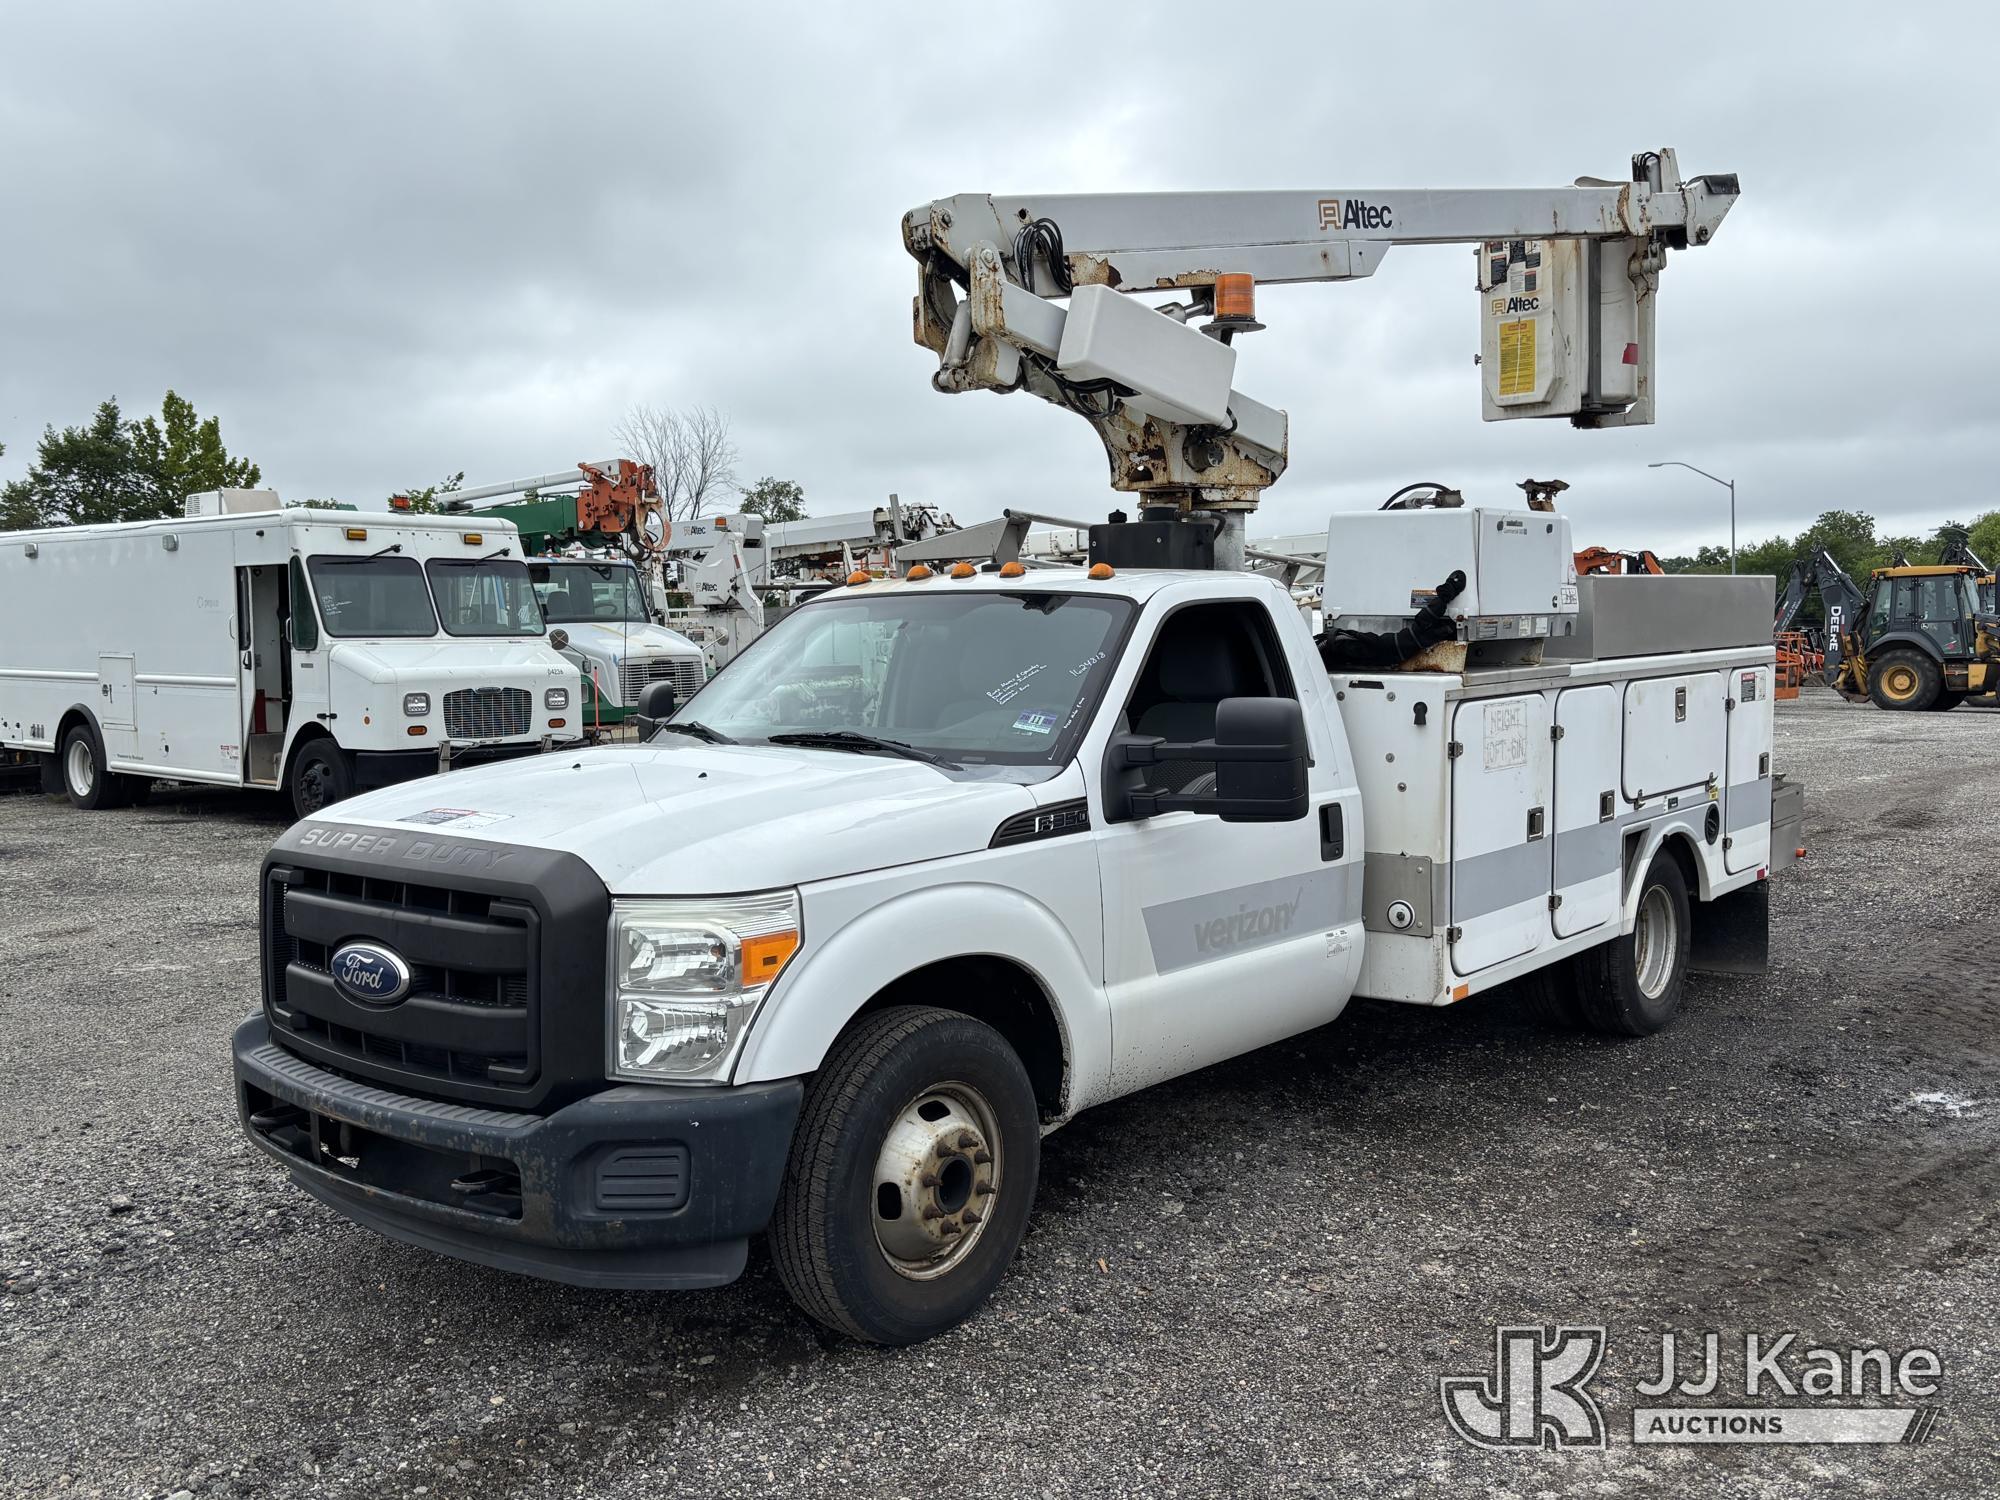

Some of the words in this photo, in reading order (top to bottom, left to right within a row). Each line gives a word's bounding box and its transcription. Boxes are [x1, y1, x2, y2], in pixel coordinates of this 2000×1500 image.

[1342, 199, 1393, 230] Altec
[1506, 296, 1540, 314] Altec
[690, 525, 707, 536] Altec
[701, 582, 718, 592] Altec
[1828, 605, 1842, 652] DEERE
[300, 828, 398, 854] SUPER
[401, 840, 516, 869] DUTY
[1193, 902, 1290, 953] verizon
[342, 953, 384, 989] Ford
